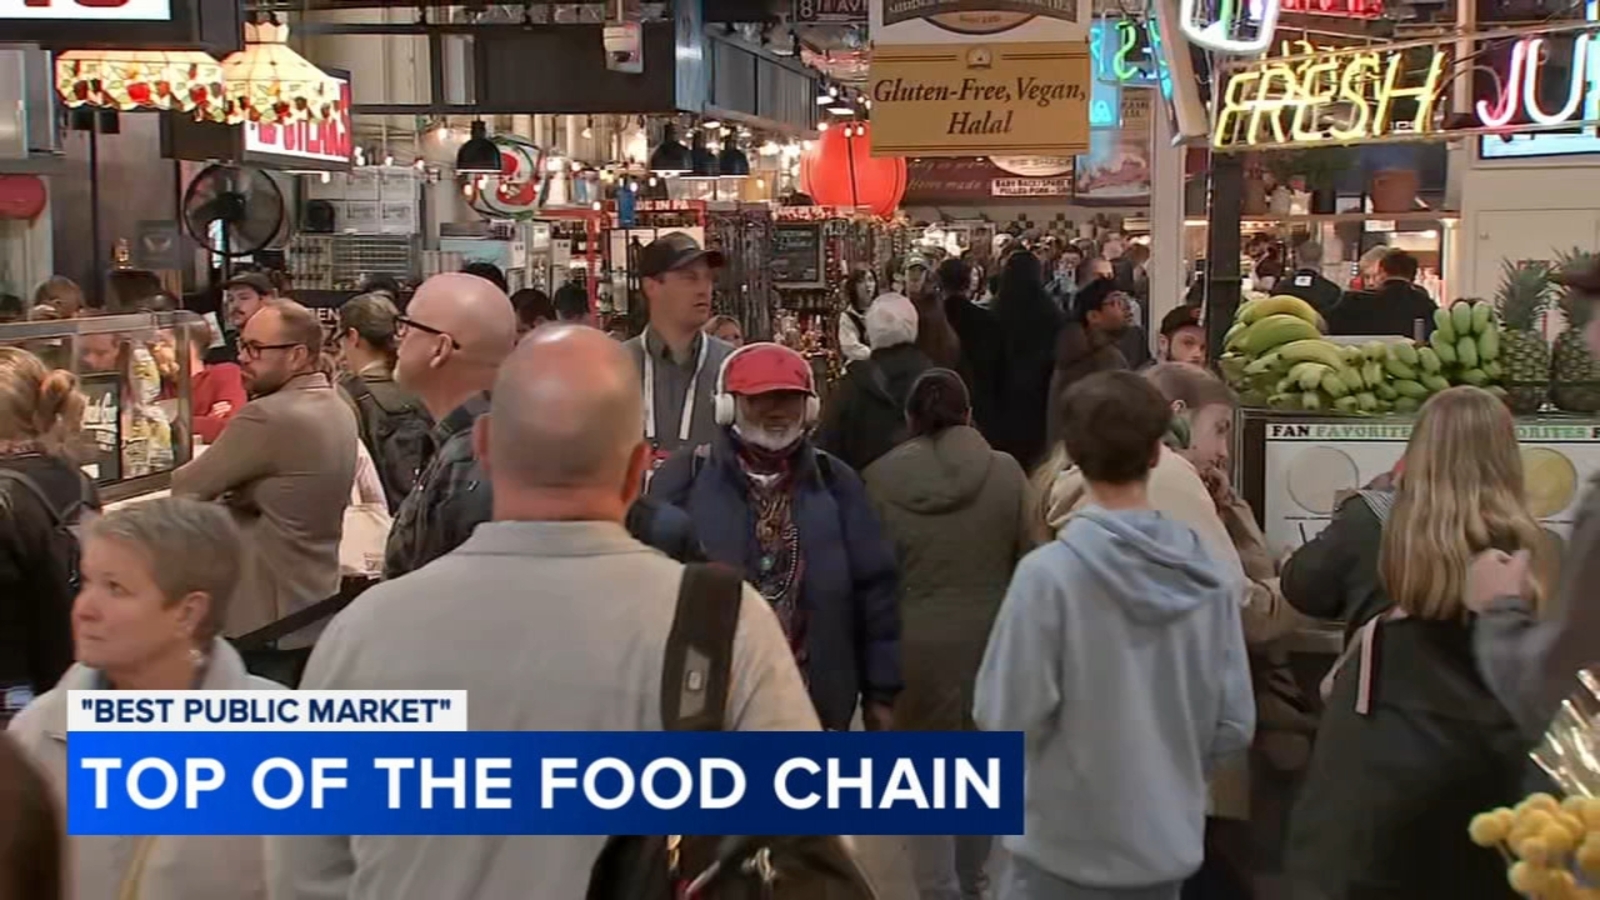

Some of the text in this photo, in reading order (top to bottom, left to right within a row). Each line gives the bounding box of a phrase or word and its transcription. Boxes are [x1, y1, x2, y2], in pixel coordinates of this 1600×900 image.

[873, 76, 1087, 107] Gluten-Free, Vegan,
[1214, 48, 1447, 148] FRESH
[946, 110, 1015, 135] Halal
[1272, 425, 1309, 437] FAN
[1317, 425, 1412, 438] FAVORITE
[1515, 426, 1588, 439] ORITES
